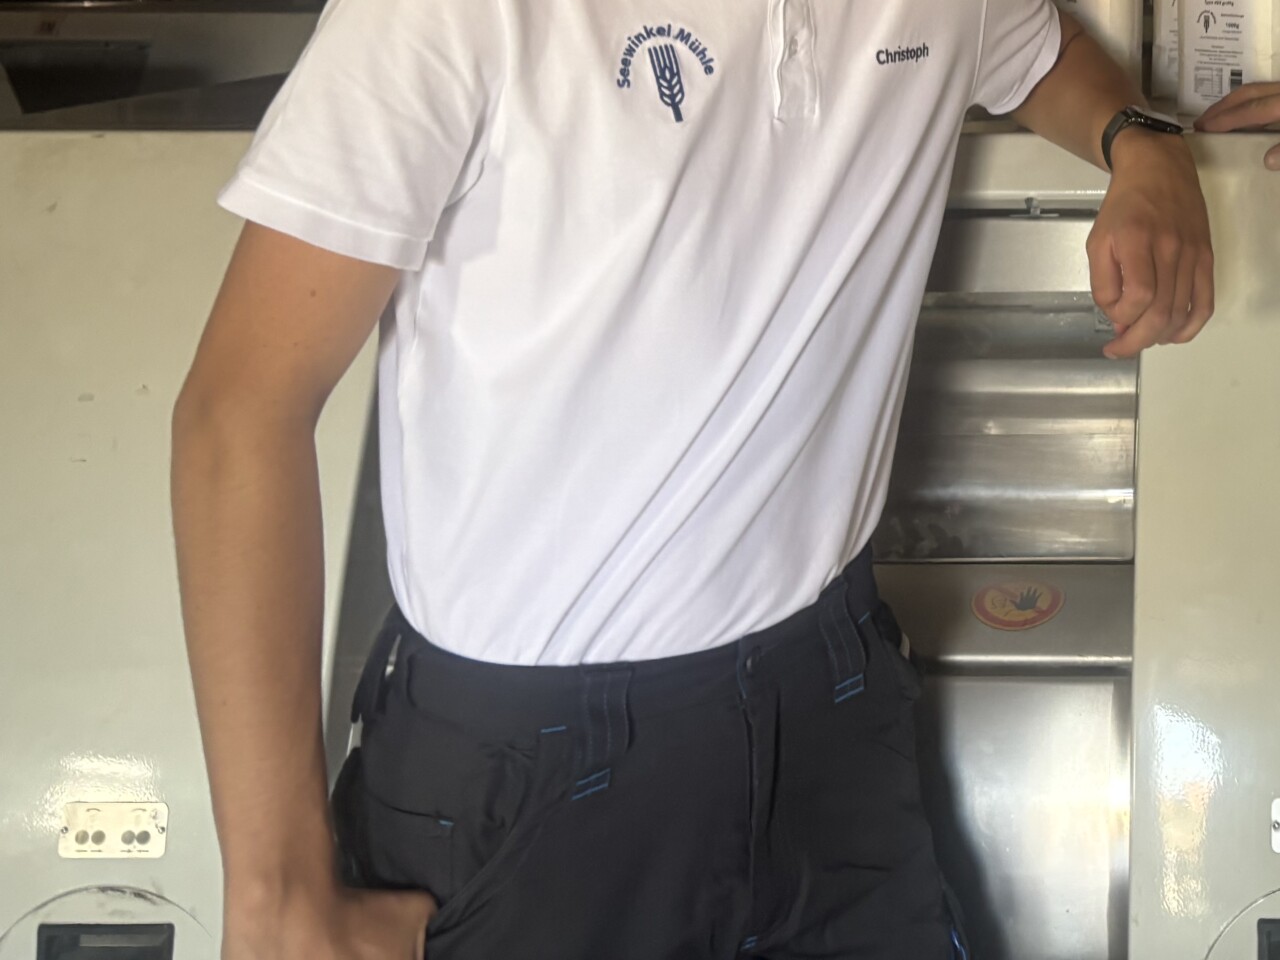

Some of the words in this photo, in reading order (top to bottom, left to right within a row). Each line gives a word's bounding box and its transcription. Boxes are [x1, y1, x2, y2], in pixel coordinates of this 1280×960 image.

[617, 24, 672, 89] Seewinkel
[673, 27, 714, 76] Mühle
[876, 43, 929, 65] Christoph
